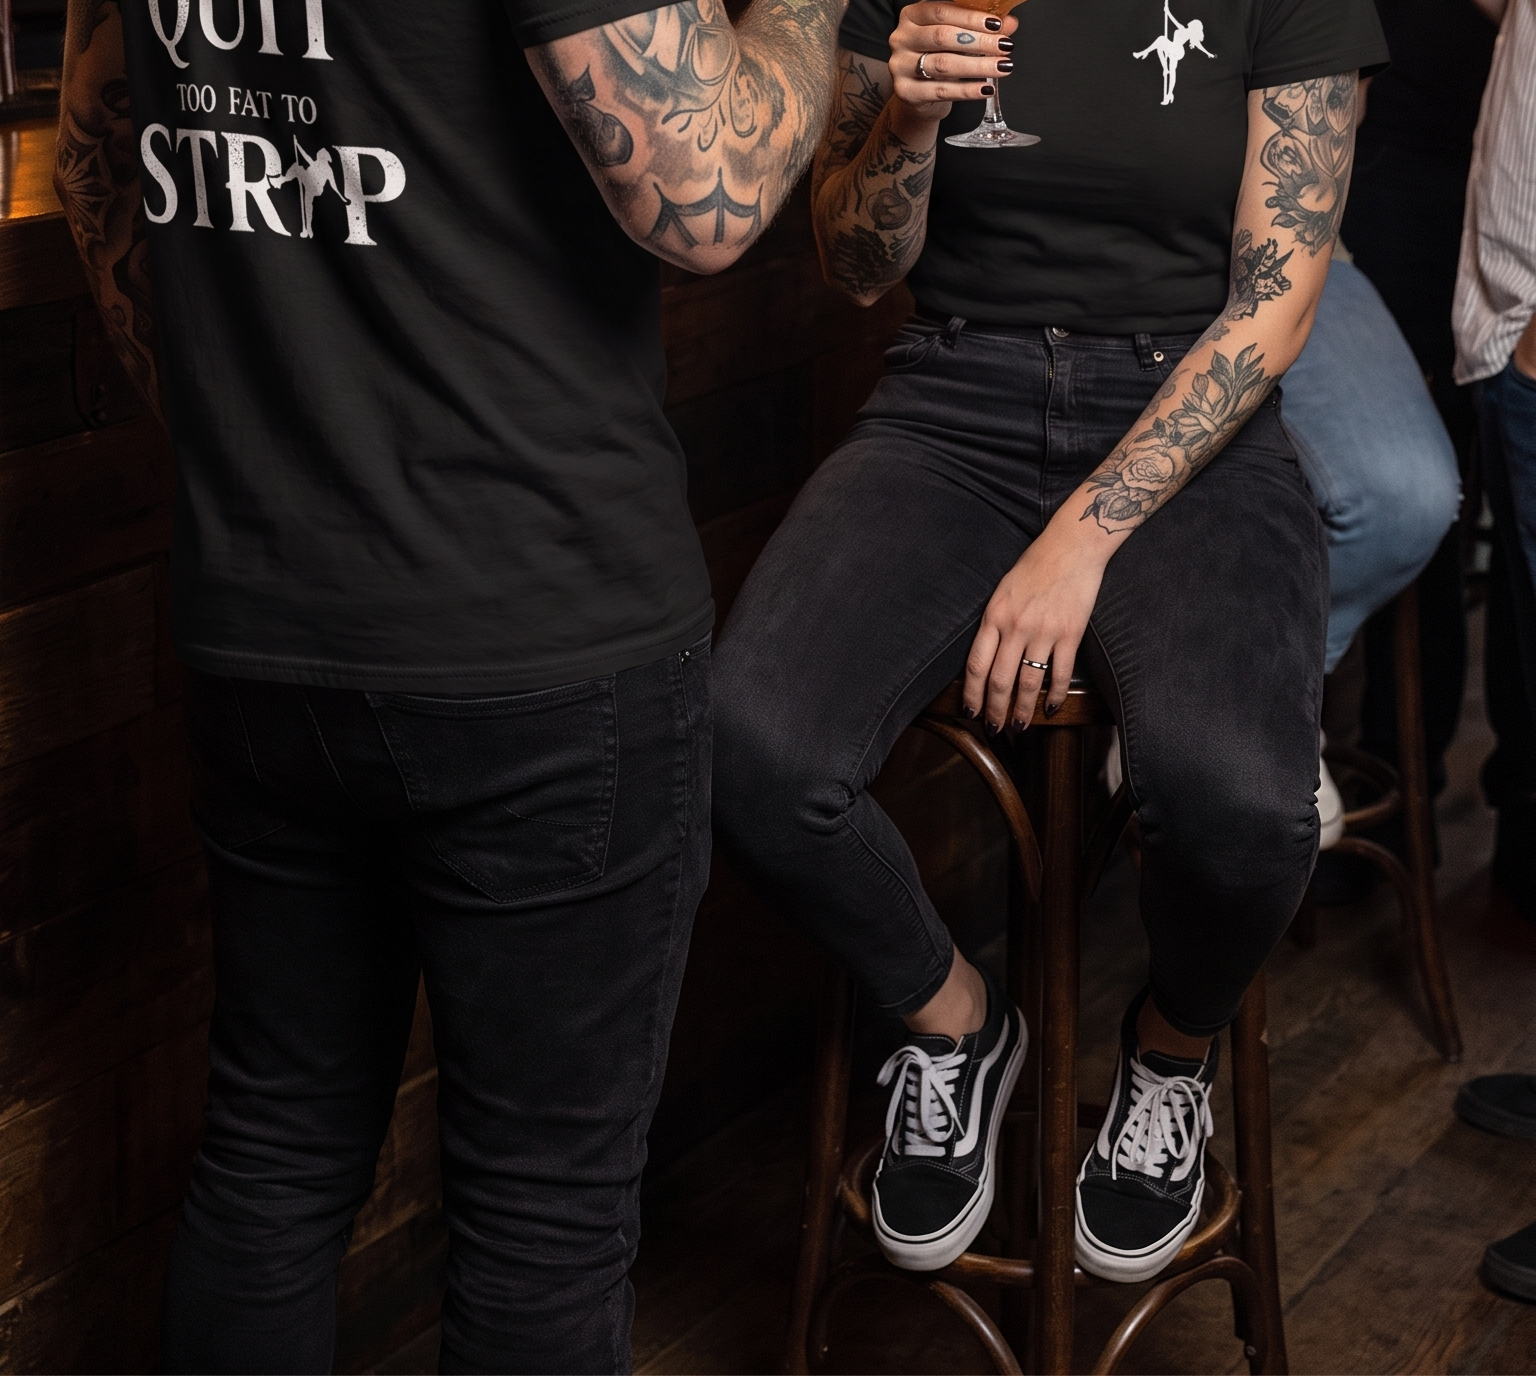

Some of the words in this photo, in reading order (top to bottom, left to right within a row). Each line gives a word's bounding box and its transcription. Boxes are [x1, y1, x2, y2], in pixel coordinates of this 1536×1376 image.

[176, 83, 217, 113] TOO
[228, 86, 272, 119] FAT
[281, 93, 317, 125] TO
[140, 123, 407, 246] STRP
